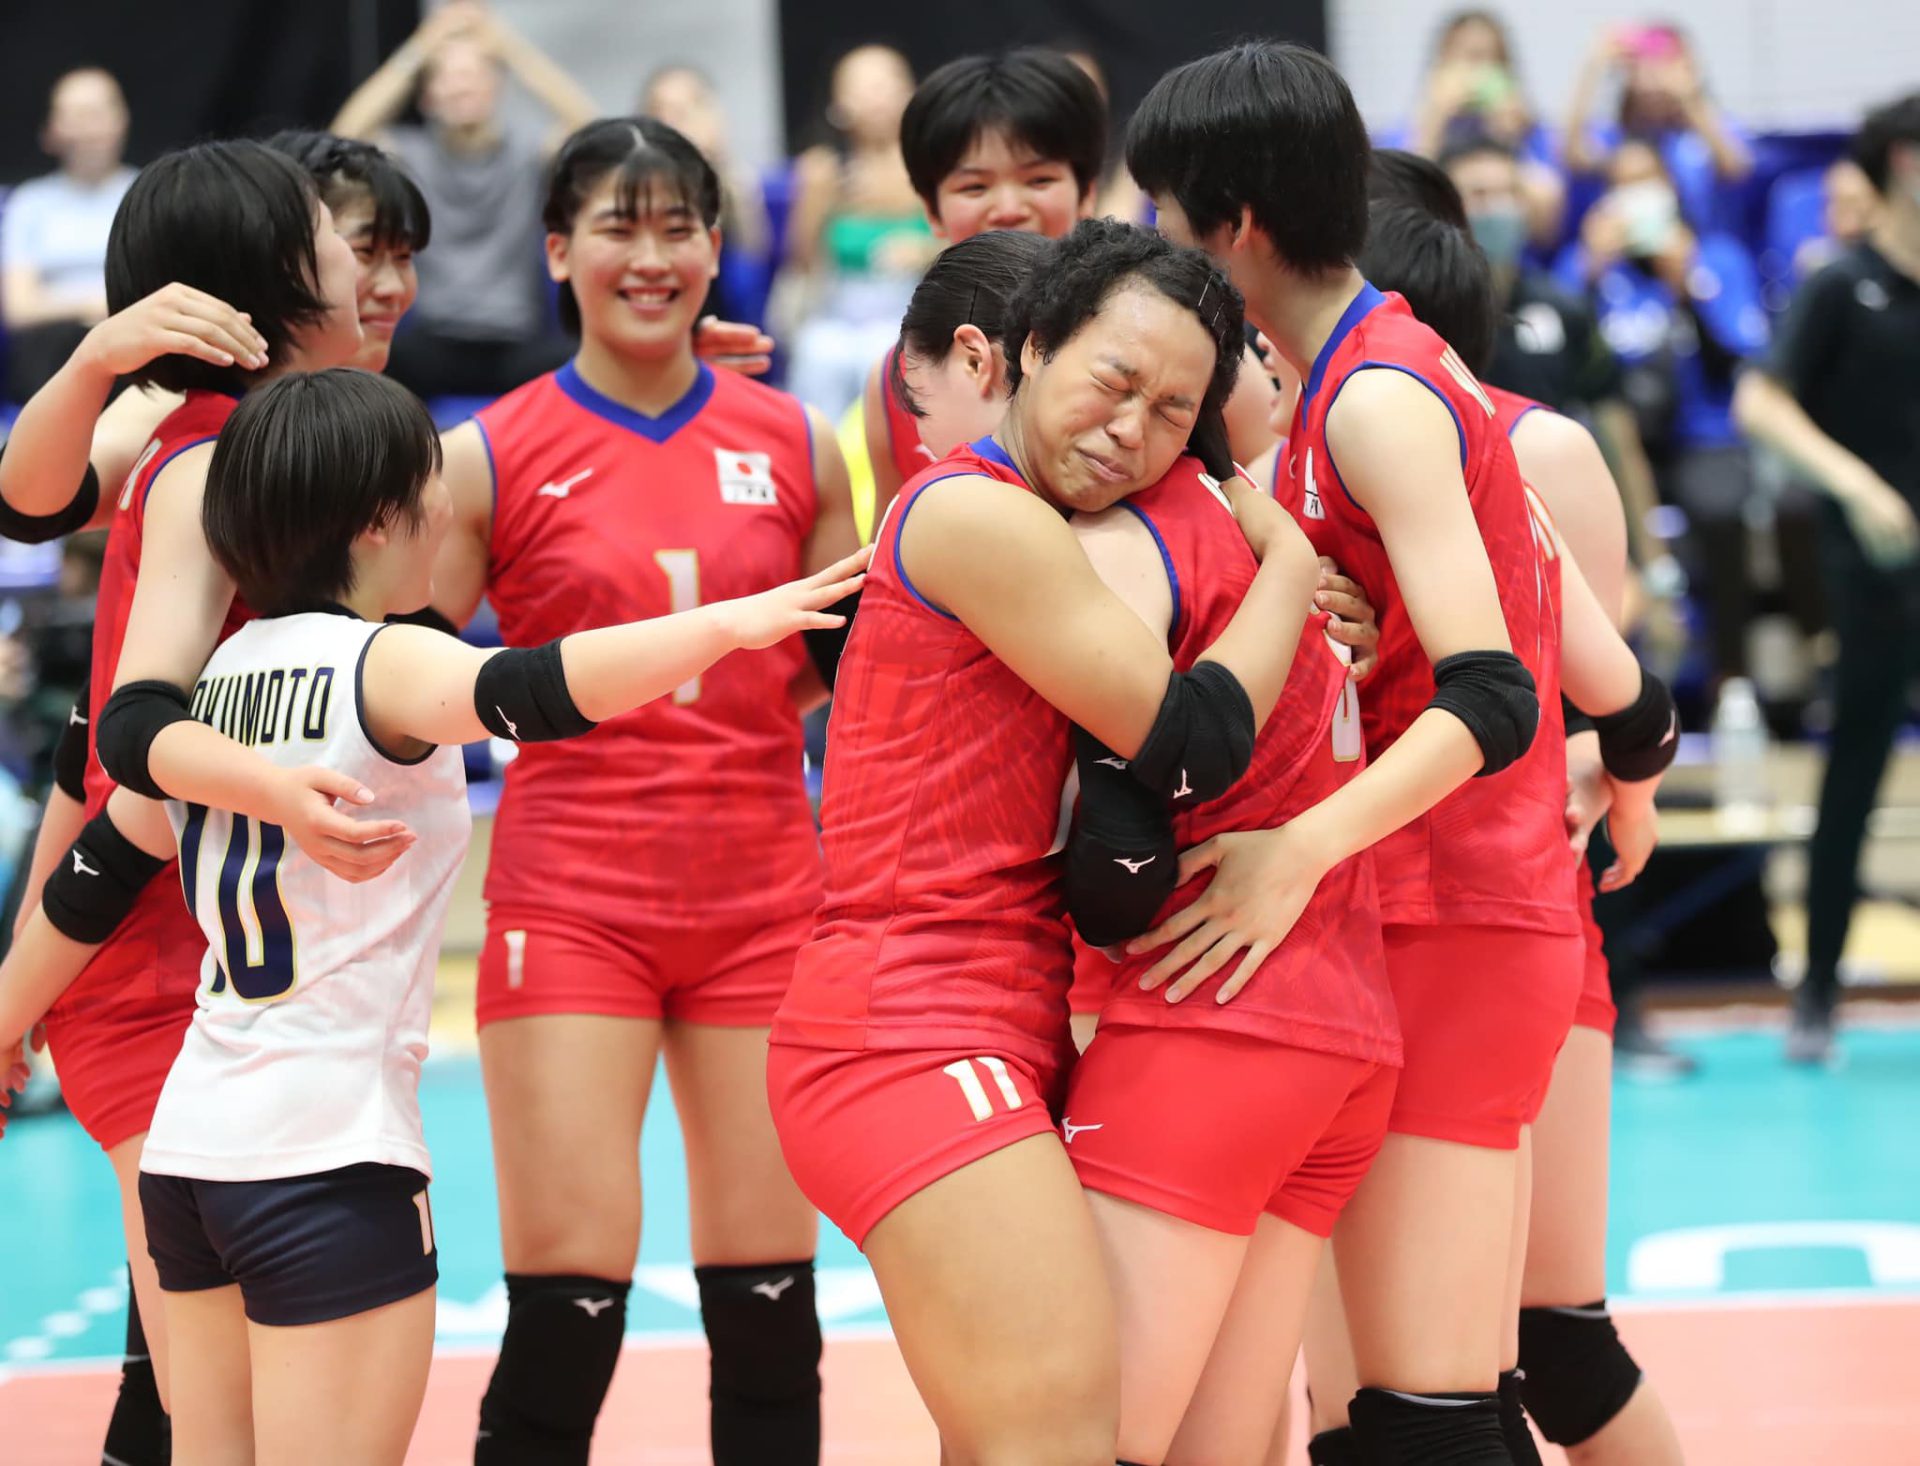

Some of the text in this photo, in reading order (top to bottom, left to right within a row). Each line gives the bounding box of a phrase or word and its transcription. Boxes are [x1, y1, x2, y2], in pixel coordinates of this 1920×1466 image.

[654, 548, 701, 707] 1
[503, 929, 526, 989] 1
[943, 1055, 1023, 1123] 11
